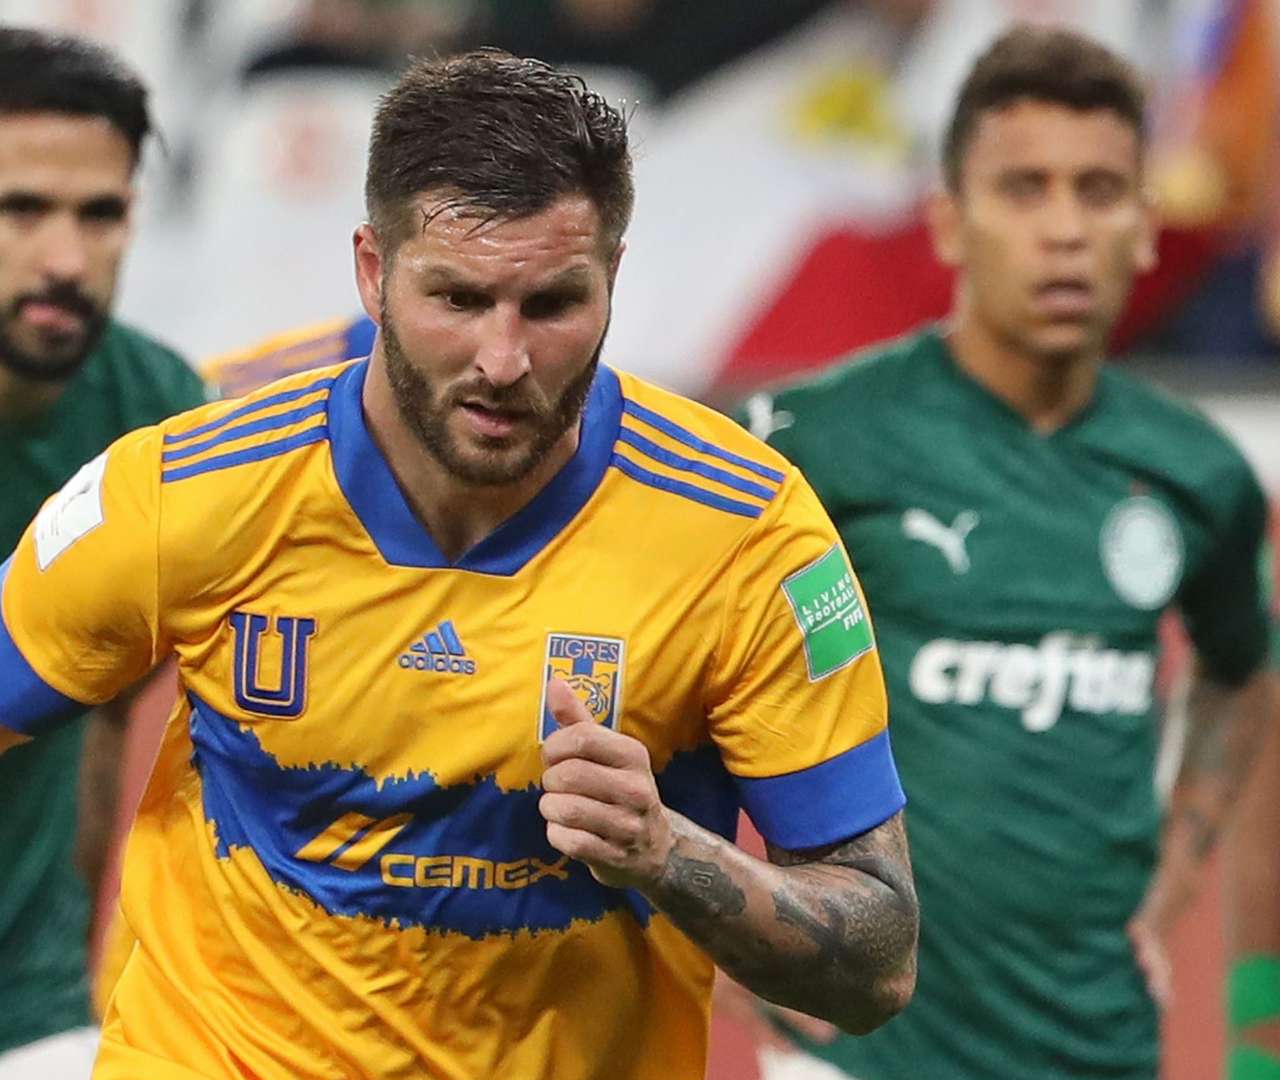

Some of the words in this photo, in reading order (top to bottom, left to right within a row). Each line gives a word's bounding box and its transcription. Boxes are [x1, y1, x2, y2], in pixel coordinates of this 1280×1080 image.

[229, 610, 316, 719] U
[399, 652, 475, 675] adidas
[551, 639, 618, 664] TIGRES
[380, 853, 570, 890] CEMEX
